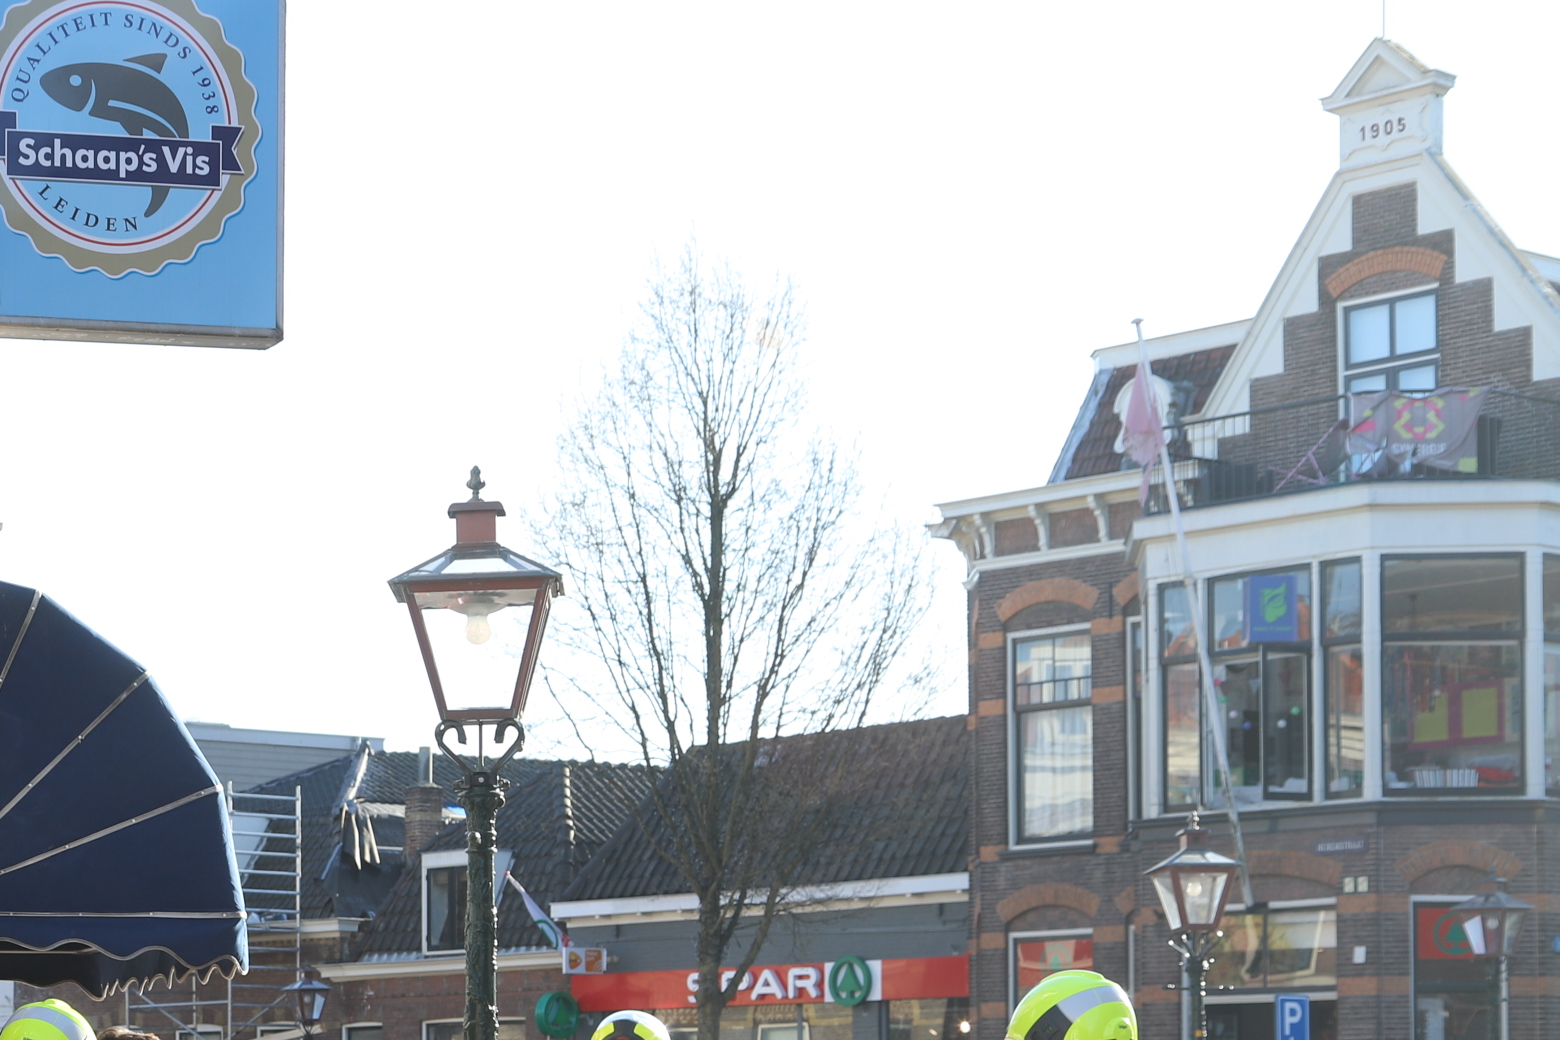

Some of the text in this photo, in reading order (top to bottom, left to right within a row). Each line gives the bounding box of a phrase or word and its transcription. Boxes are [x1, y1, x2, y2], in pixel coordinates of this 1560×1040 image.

[10, 11, 219, 116] QUALITEIT SINDS 1938
[1358, 116, 1407, 142] 1905
[17, 138, 211, 178] Schaap's Vis
[37, 184, 139, 233] LEIDEN
[1284, 1001, 1303, 1036] P
